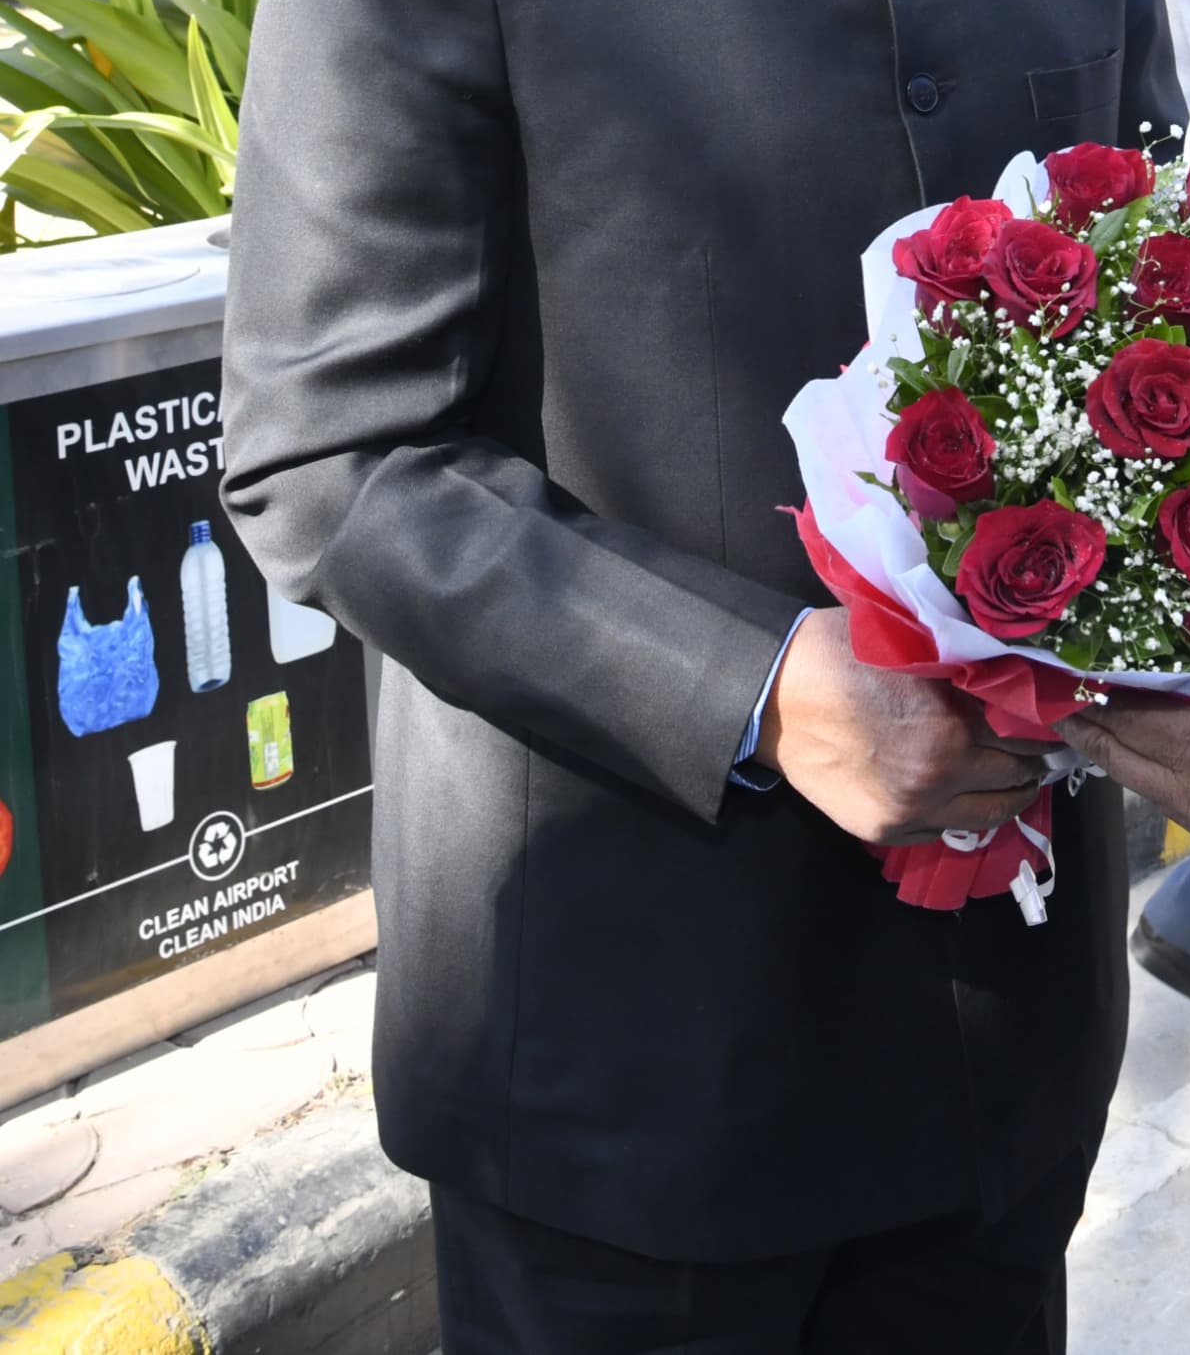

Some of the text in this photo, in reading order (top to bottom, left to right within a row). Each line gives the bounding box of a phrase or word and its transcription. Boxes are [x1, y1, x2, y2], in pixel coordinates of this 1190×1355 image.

[56, 391, 224, 460] PLASTIC
[124, 436, 226, 492] WAST
[138, 860, 300, 941] CLEAN AIRPORT
[158, 893, 286, 959] CLEAN INDIA
